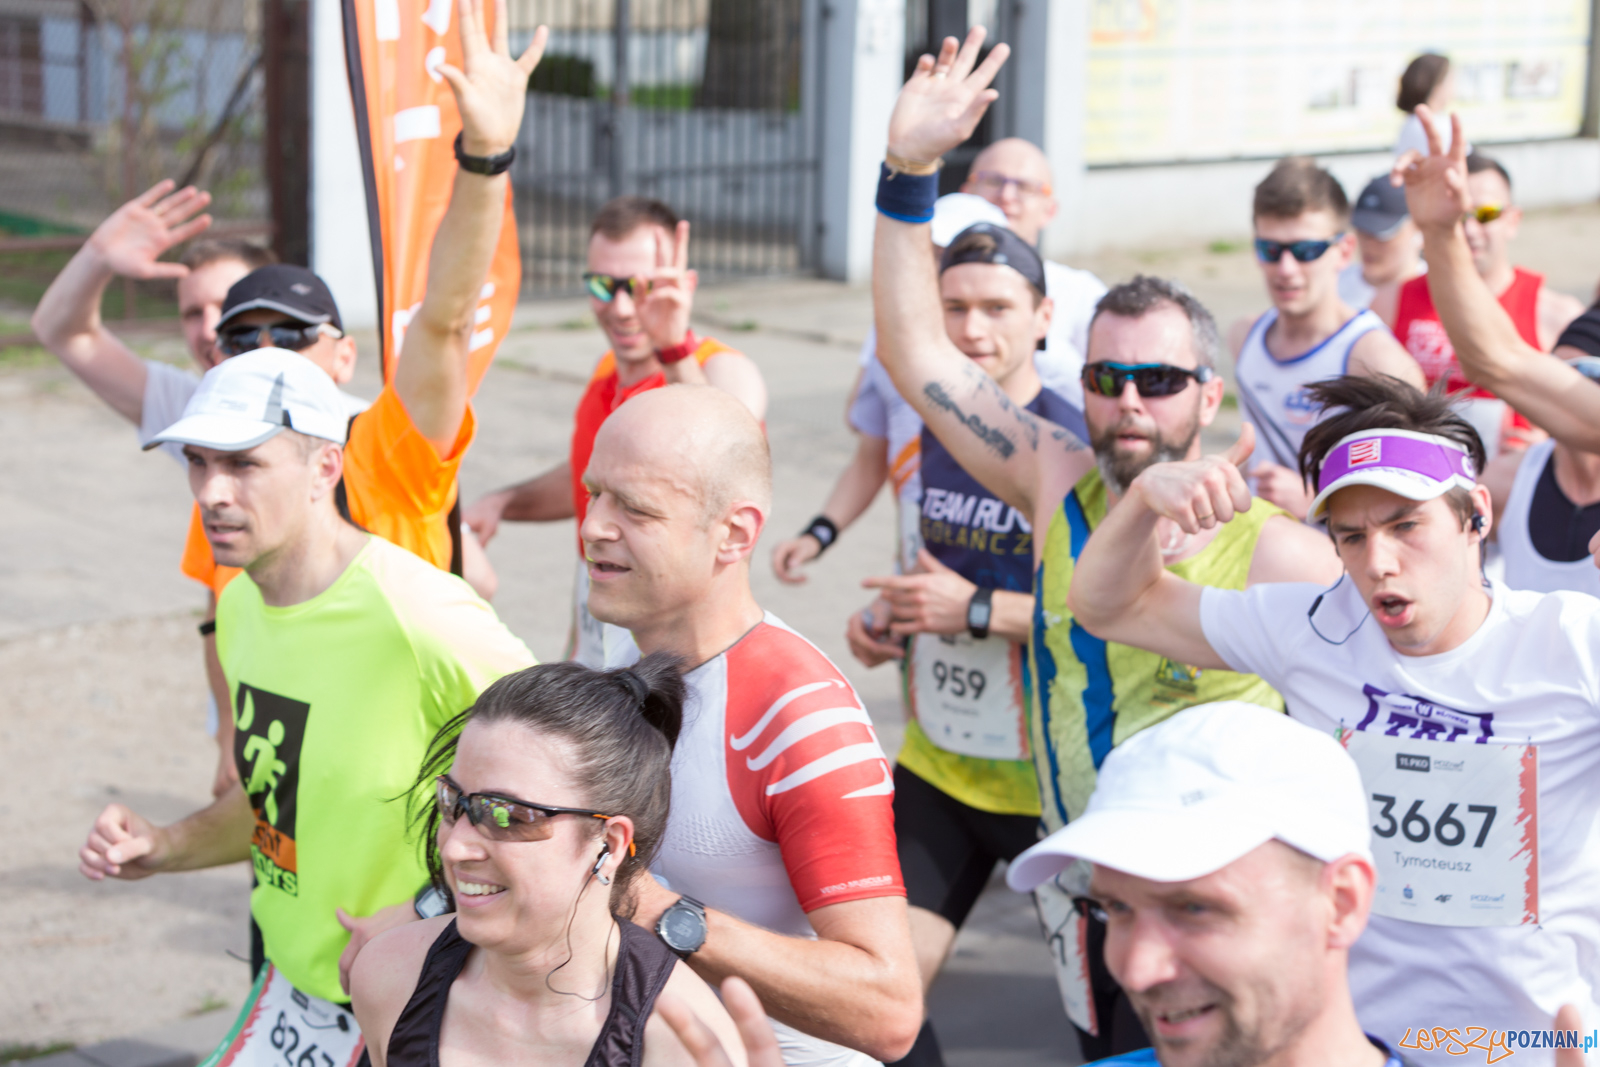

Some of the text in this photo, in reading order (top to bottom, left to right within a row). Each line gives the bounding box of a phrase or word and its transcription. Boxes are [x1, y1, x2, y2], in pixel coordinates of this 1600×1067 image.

[922, 487, 978, 526] TEAM
[932, 659, 987, 701] 959
[1372, 793, 1498, 848] 3667
[1394, 851, 1473, 873] Tymoteusz
